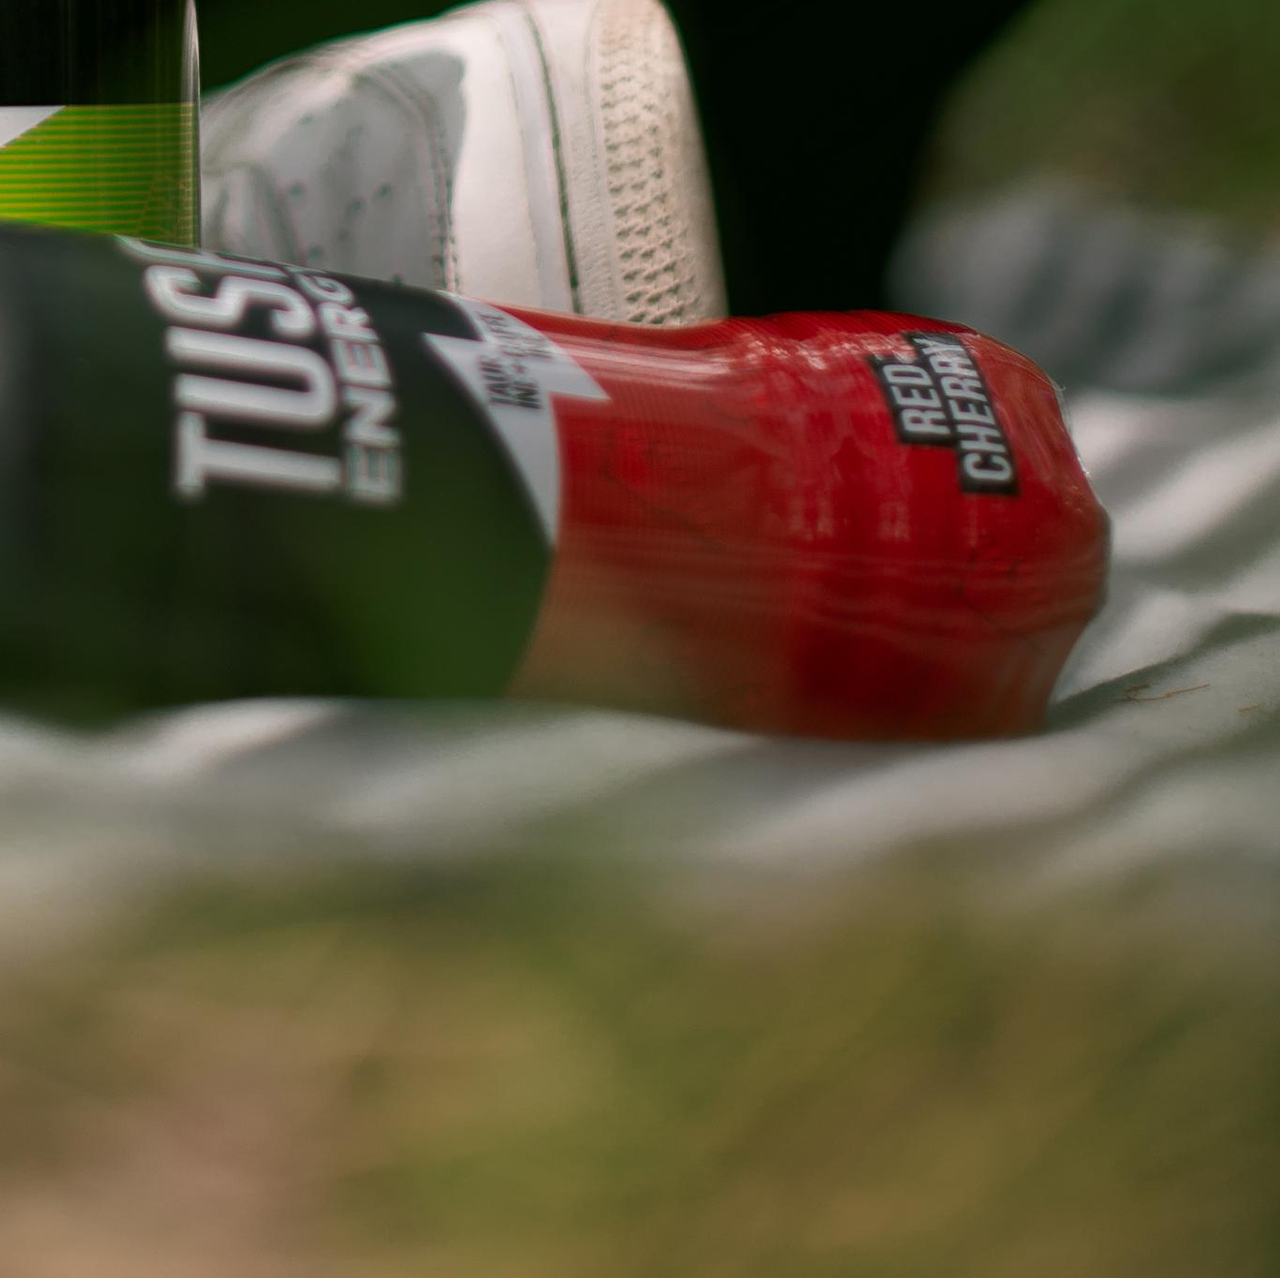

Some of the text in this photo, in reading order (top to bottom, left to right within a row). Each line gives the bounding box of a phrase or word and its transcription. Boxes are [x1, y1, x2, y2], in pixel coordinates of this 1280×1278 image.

[287, 266, 403, 504] ENERG
[882, 363, 951, 435] RED
[913, 336, 1014, 482] CHERRY
